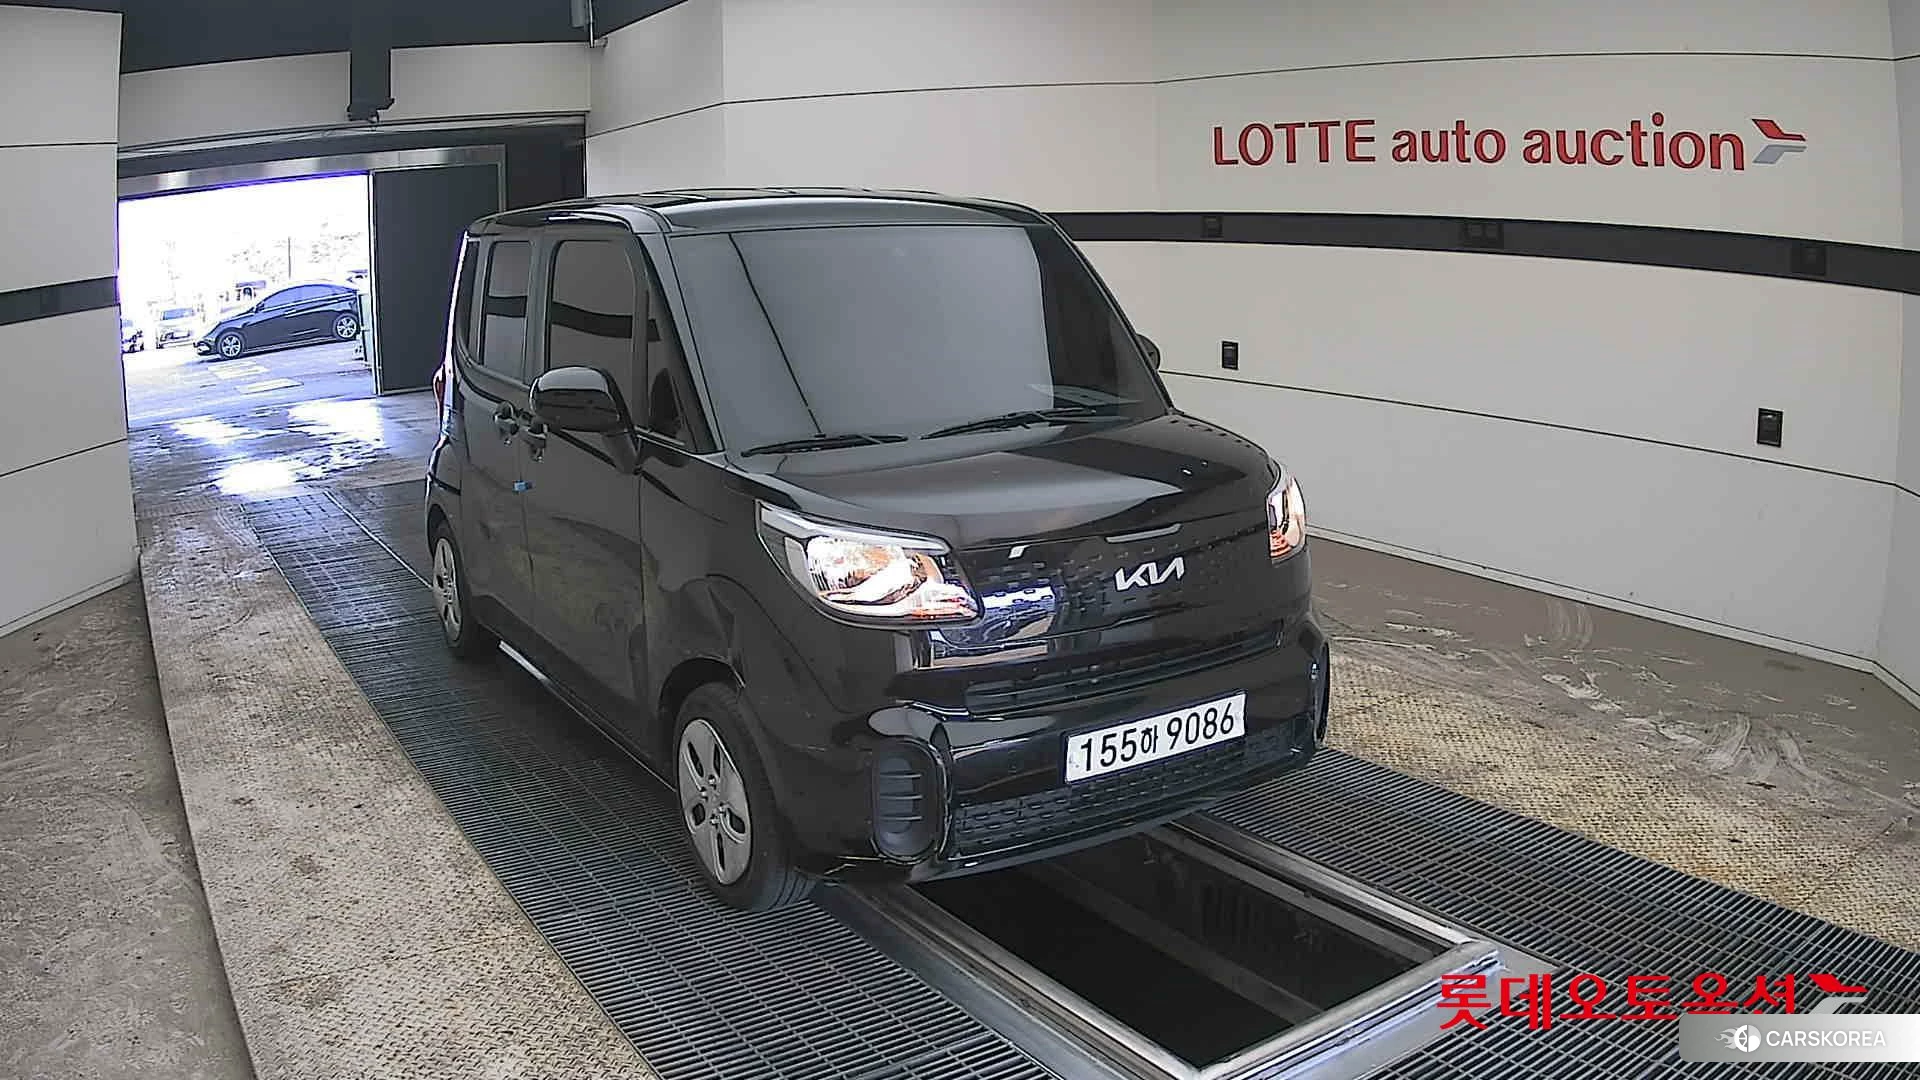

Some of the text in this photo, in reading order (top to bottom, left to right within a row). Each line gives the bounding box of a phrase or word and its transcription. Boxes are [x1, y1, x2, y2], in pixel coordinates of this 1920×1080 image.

[1212, 111, 1746, 171] LOTTE auto auction
[1114, 556, 1186, 592] KIA
[1080, 702, 1235, 772] 155하 9086
